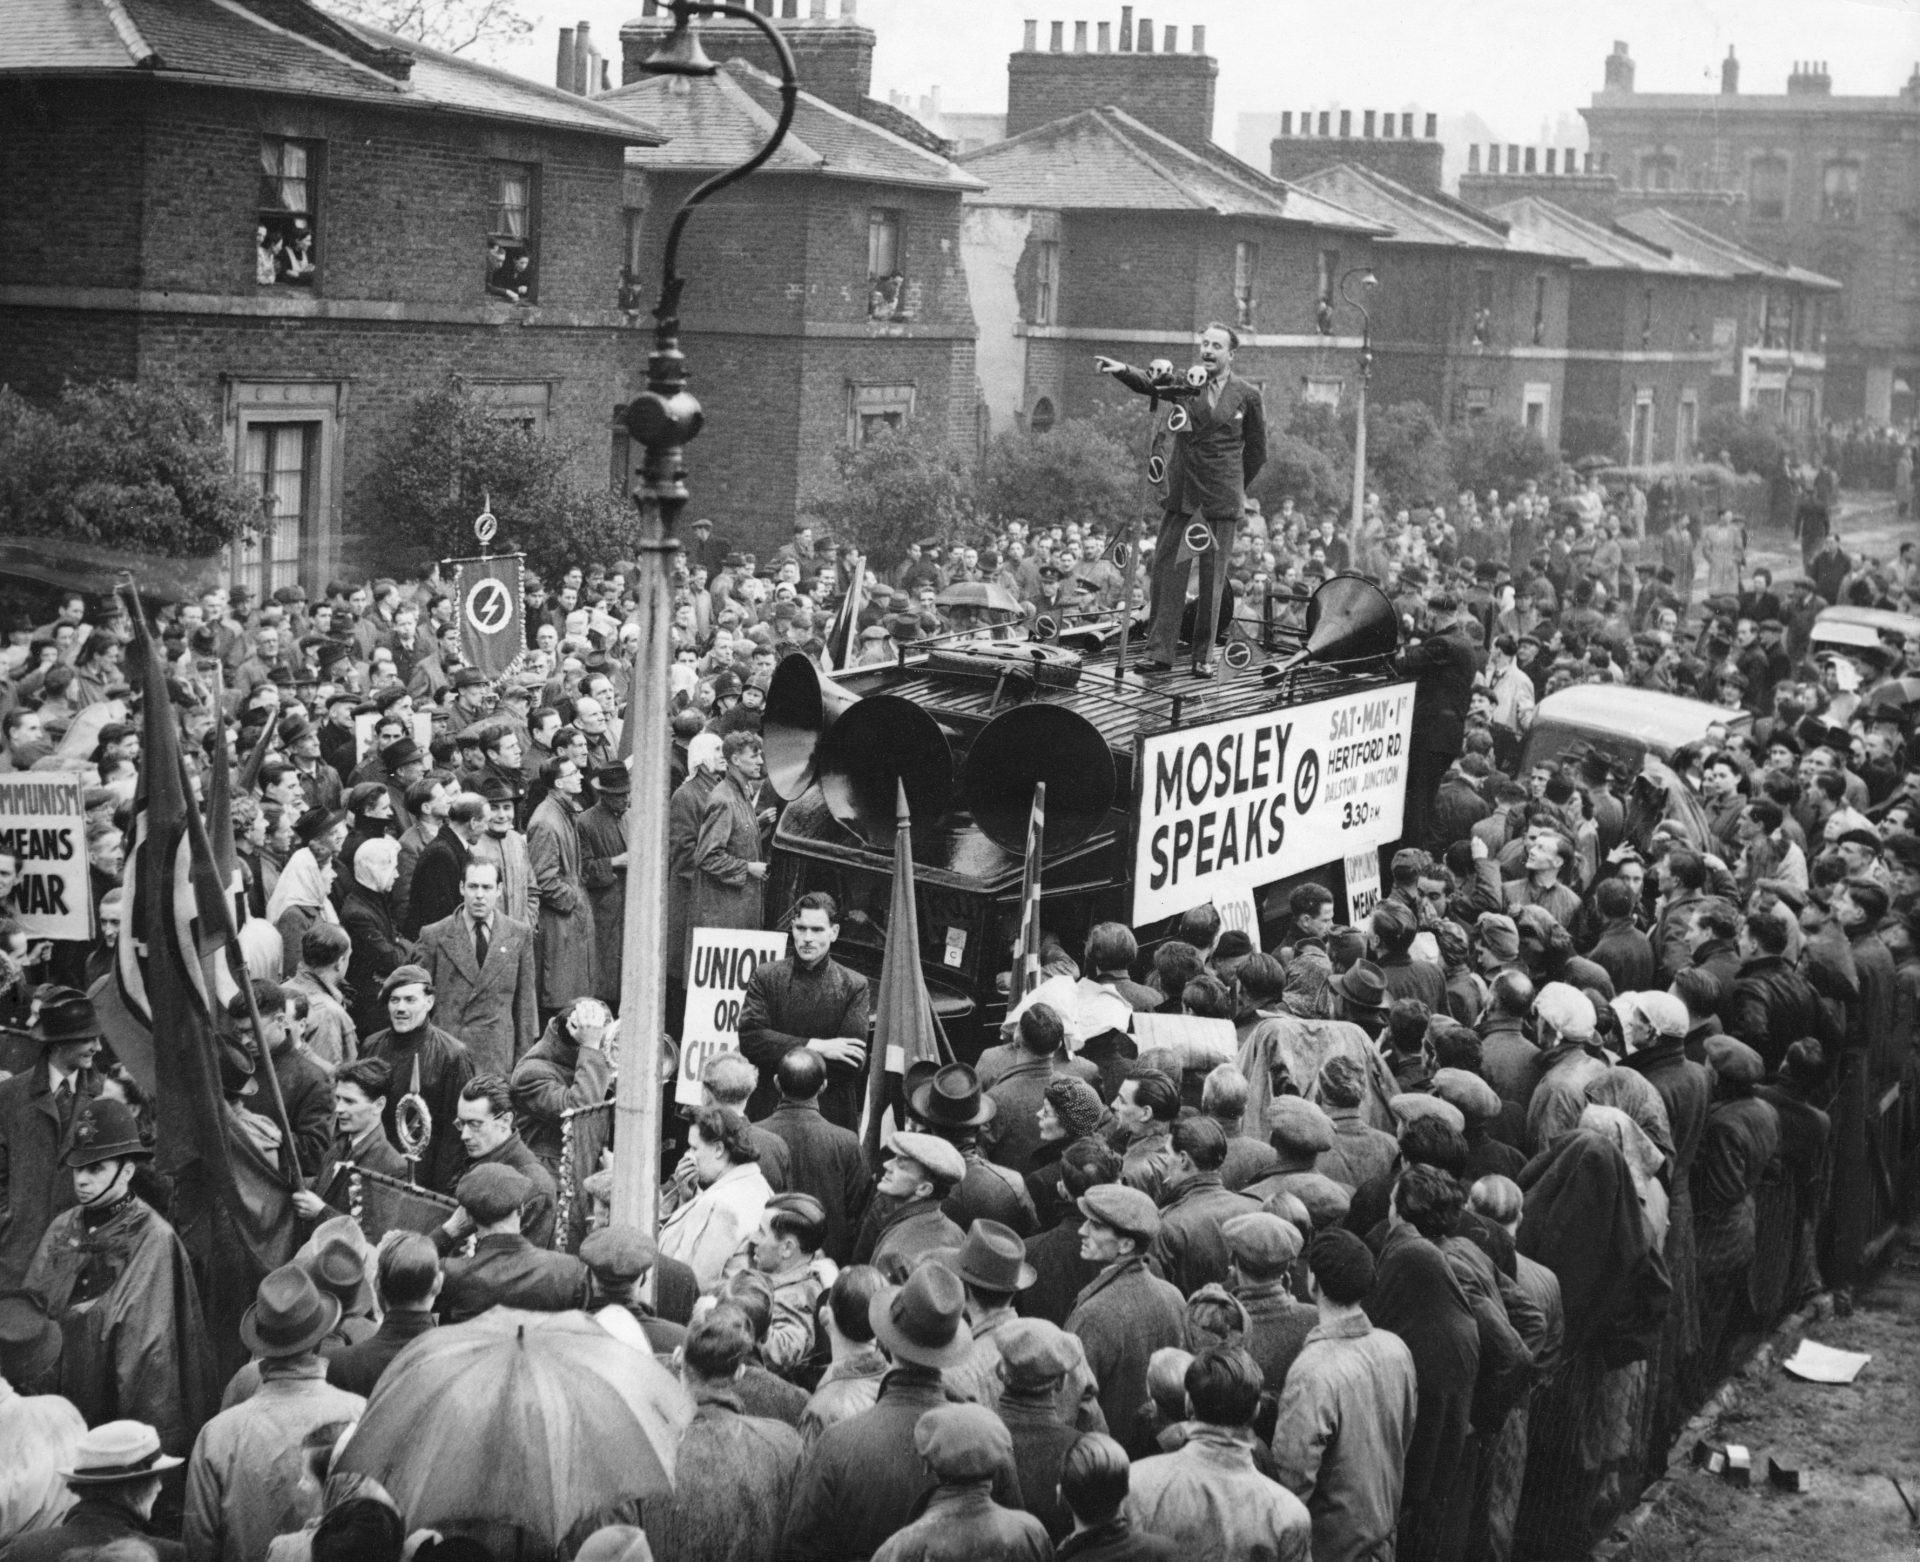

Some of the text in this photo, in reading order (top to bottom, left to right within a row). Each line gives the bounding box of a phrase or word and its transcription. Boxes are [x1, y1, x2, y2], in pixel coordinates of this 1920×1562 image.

[1329, 706, 1357, 740] SAT
[1362, 699, 1389, 733] MAY
[1155, 722, 1293, 816] MOSLEY
[1327, 737, 1384, 775] HERTFORD
[1324, 764, 1399, 804] DALSTON JUNCTION
[1341, 801, 1369, 830] 3.30
[1150, 793, 1286, 890] SPEAKS
[1221, 900, 1250, 933] STOP
[714, 1000, 741, 1032] OR
